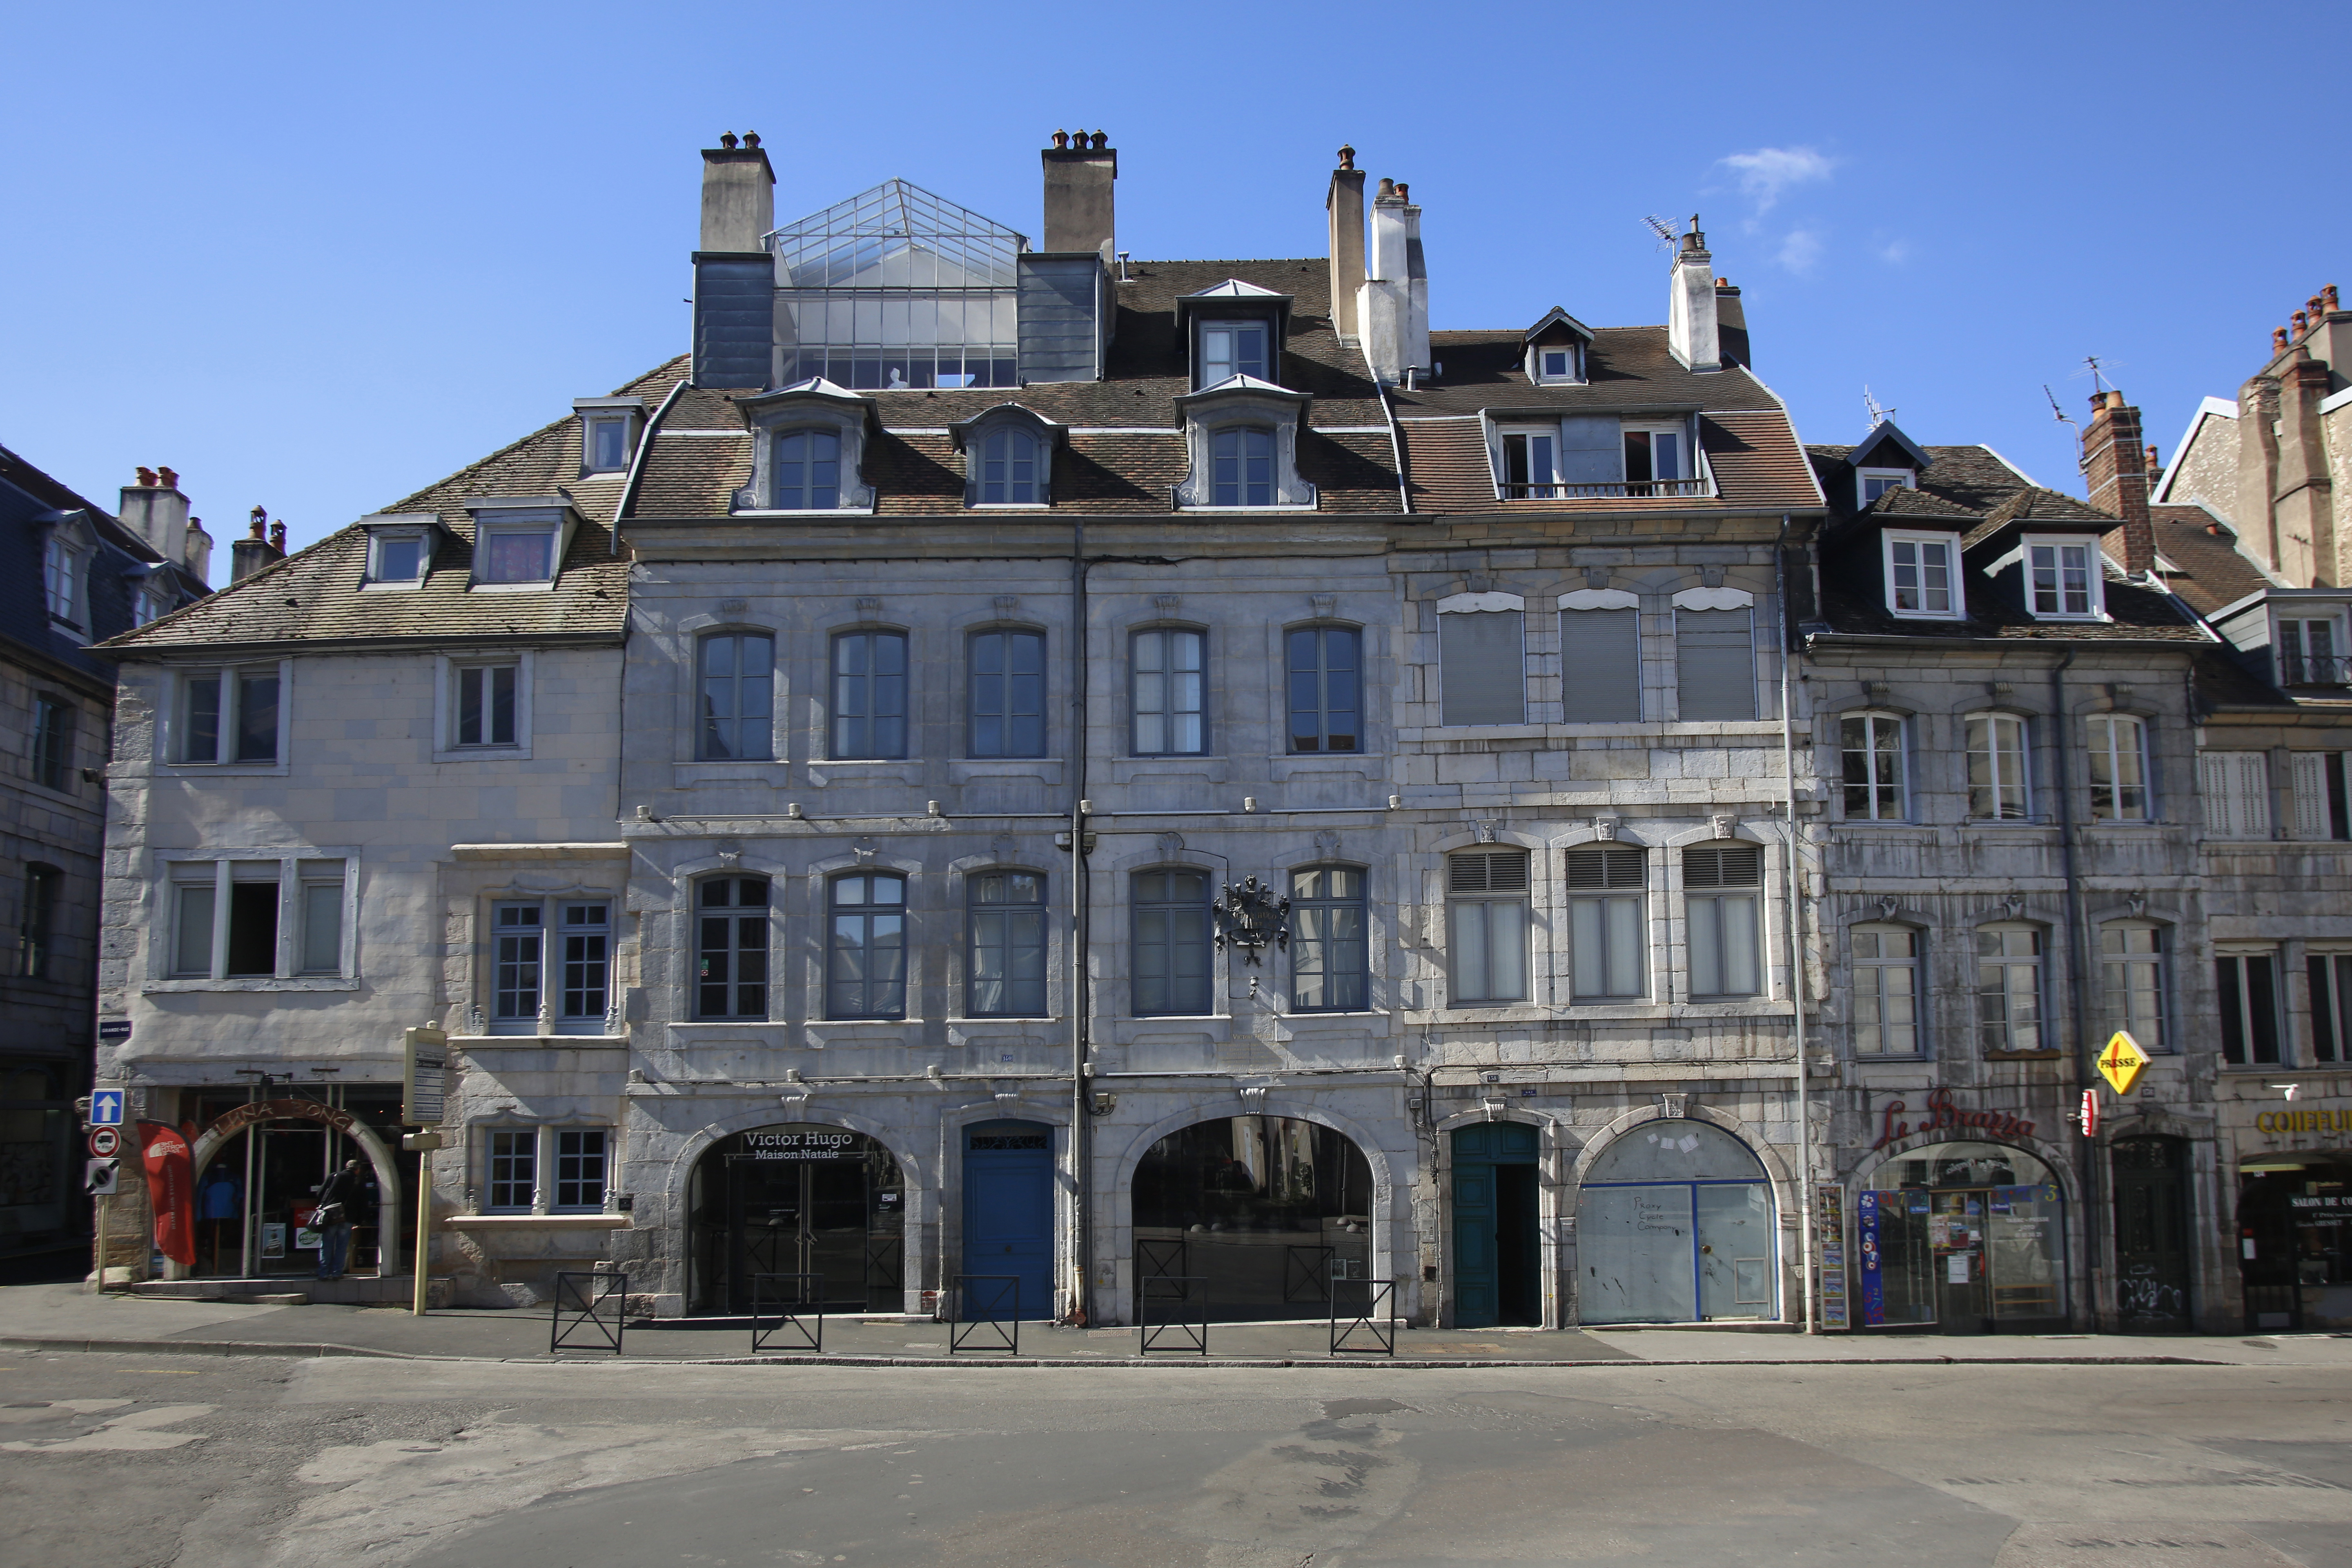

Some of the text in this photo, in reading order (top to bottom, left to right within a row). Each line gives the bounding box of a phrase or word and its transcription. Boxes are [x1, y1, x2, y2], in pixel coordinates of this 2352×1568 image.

[2100, 1058, 2136, 1068] PRESSE
[214, 1102, 274, 1136] LUNA
[1873, 1088, 2036, 1150] Le Brazza
[2080, 1092, 2089, 1136] TABAC
[2258, 1110, 2352, 1133] COIFFU
[744, 1131, 852, 1148] Victor Hugo
[755, 1149, 839, 1159] Maison Natale
[2045, 1185, 2058, 1201] 3
[2292, 1198, 2322, 1207] SALON
[2325, 1197, 2339, 1206] DE
[1639, 1211, 1664, 1222] Cycle
